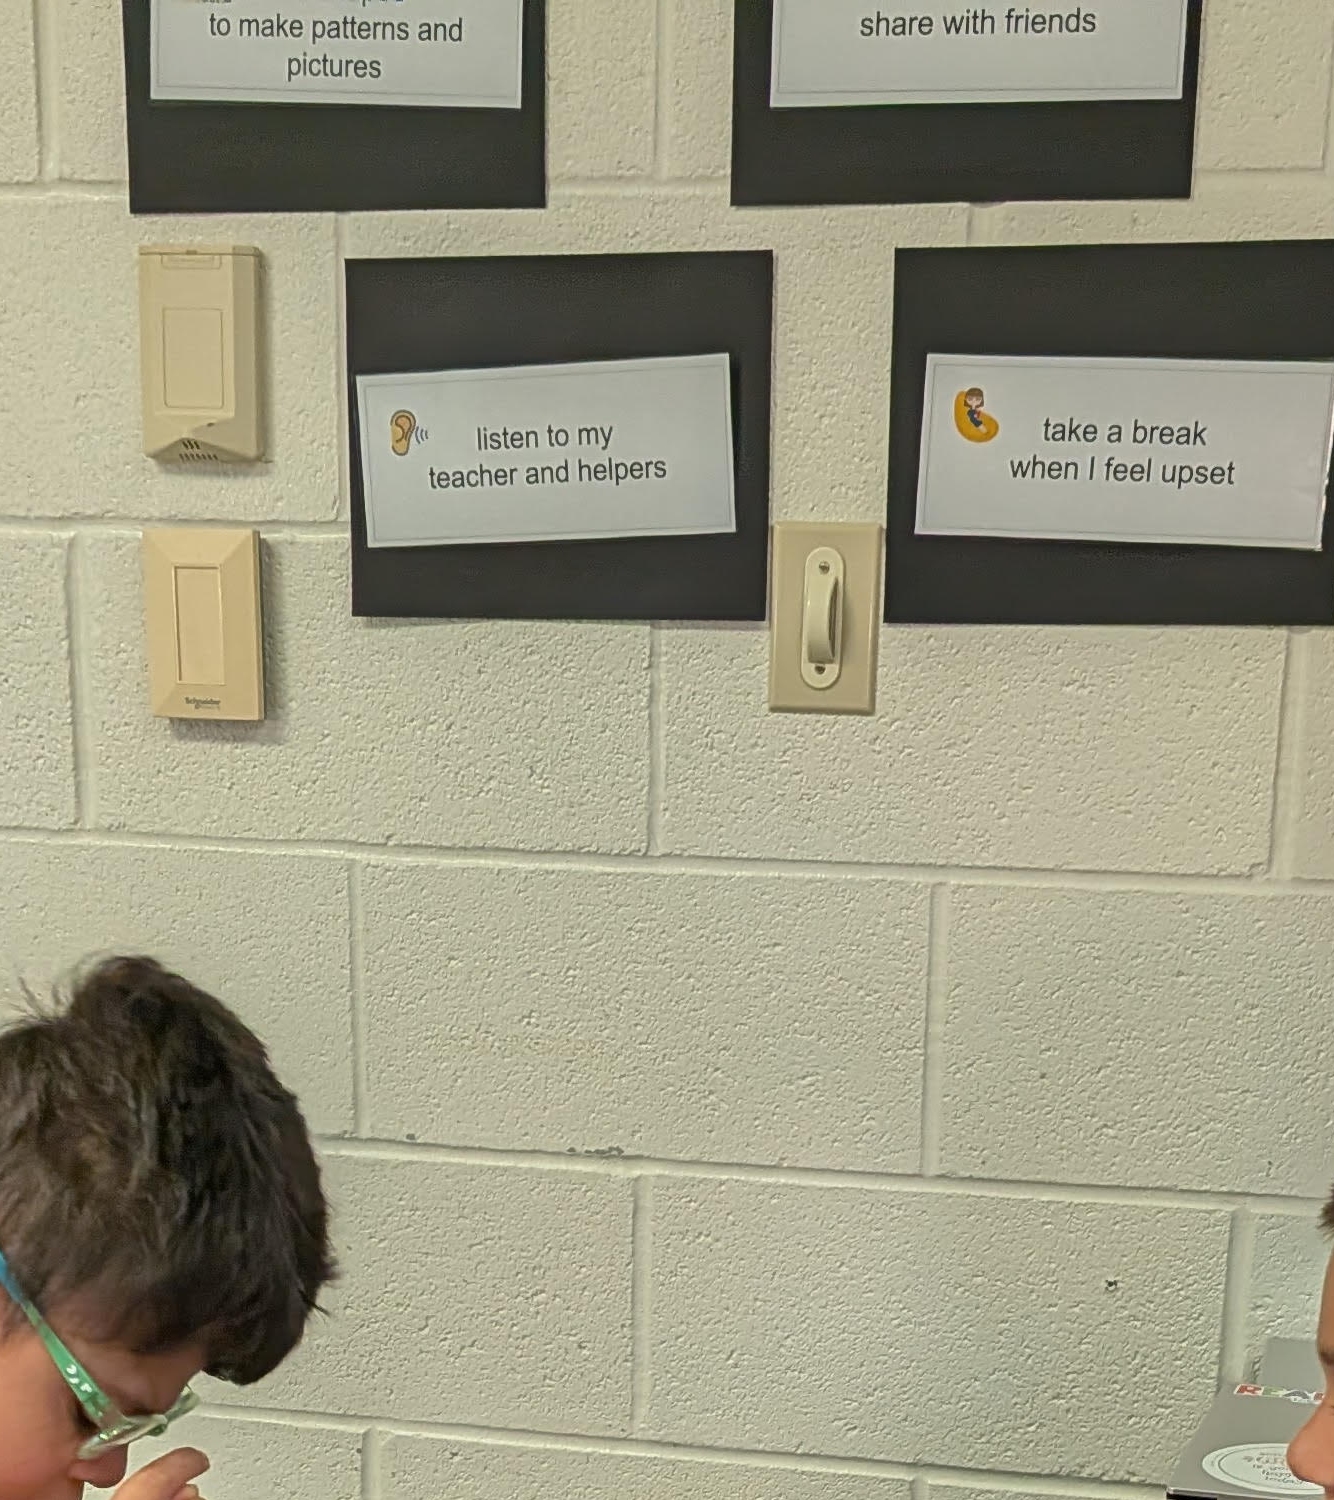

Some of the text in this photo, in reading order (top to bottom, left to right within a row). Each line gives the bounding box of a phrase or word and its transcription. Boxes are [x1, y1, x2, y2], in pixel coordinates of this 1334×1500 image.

[208, 13, 463, 45] to make patterns and
[860, 8, 1097, 37] share with friends
[286, 52, 382, 82] pictures
[476, 424, 613, 451] listen to my
[1043, 417, 1208, 446] take a break
[428, 458, 667, 489] teacher and helpers
[1009, 455, 1236, 489] when I feel upset
